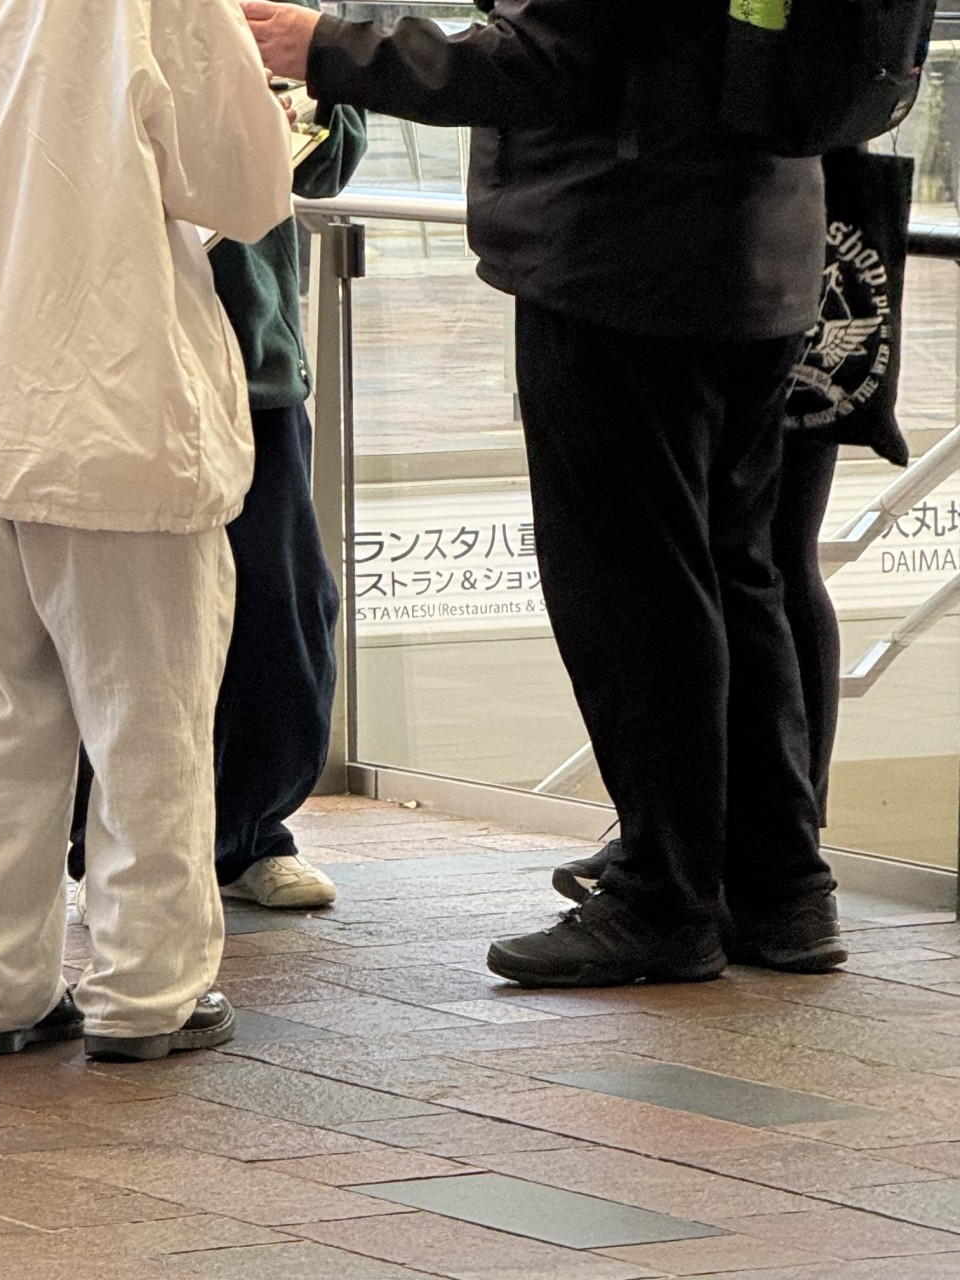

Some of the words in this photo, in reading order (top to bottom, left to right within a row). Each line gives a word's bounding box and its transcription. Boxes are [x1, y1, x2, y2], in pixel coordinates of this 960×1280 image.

[881, 547, 960, 573] DAIMA
[393, 603, 435, 619] YAESU
[438, 601, 522, 617] (Restaurants
[525, 599, 536, 612] &
